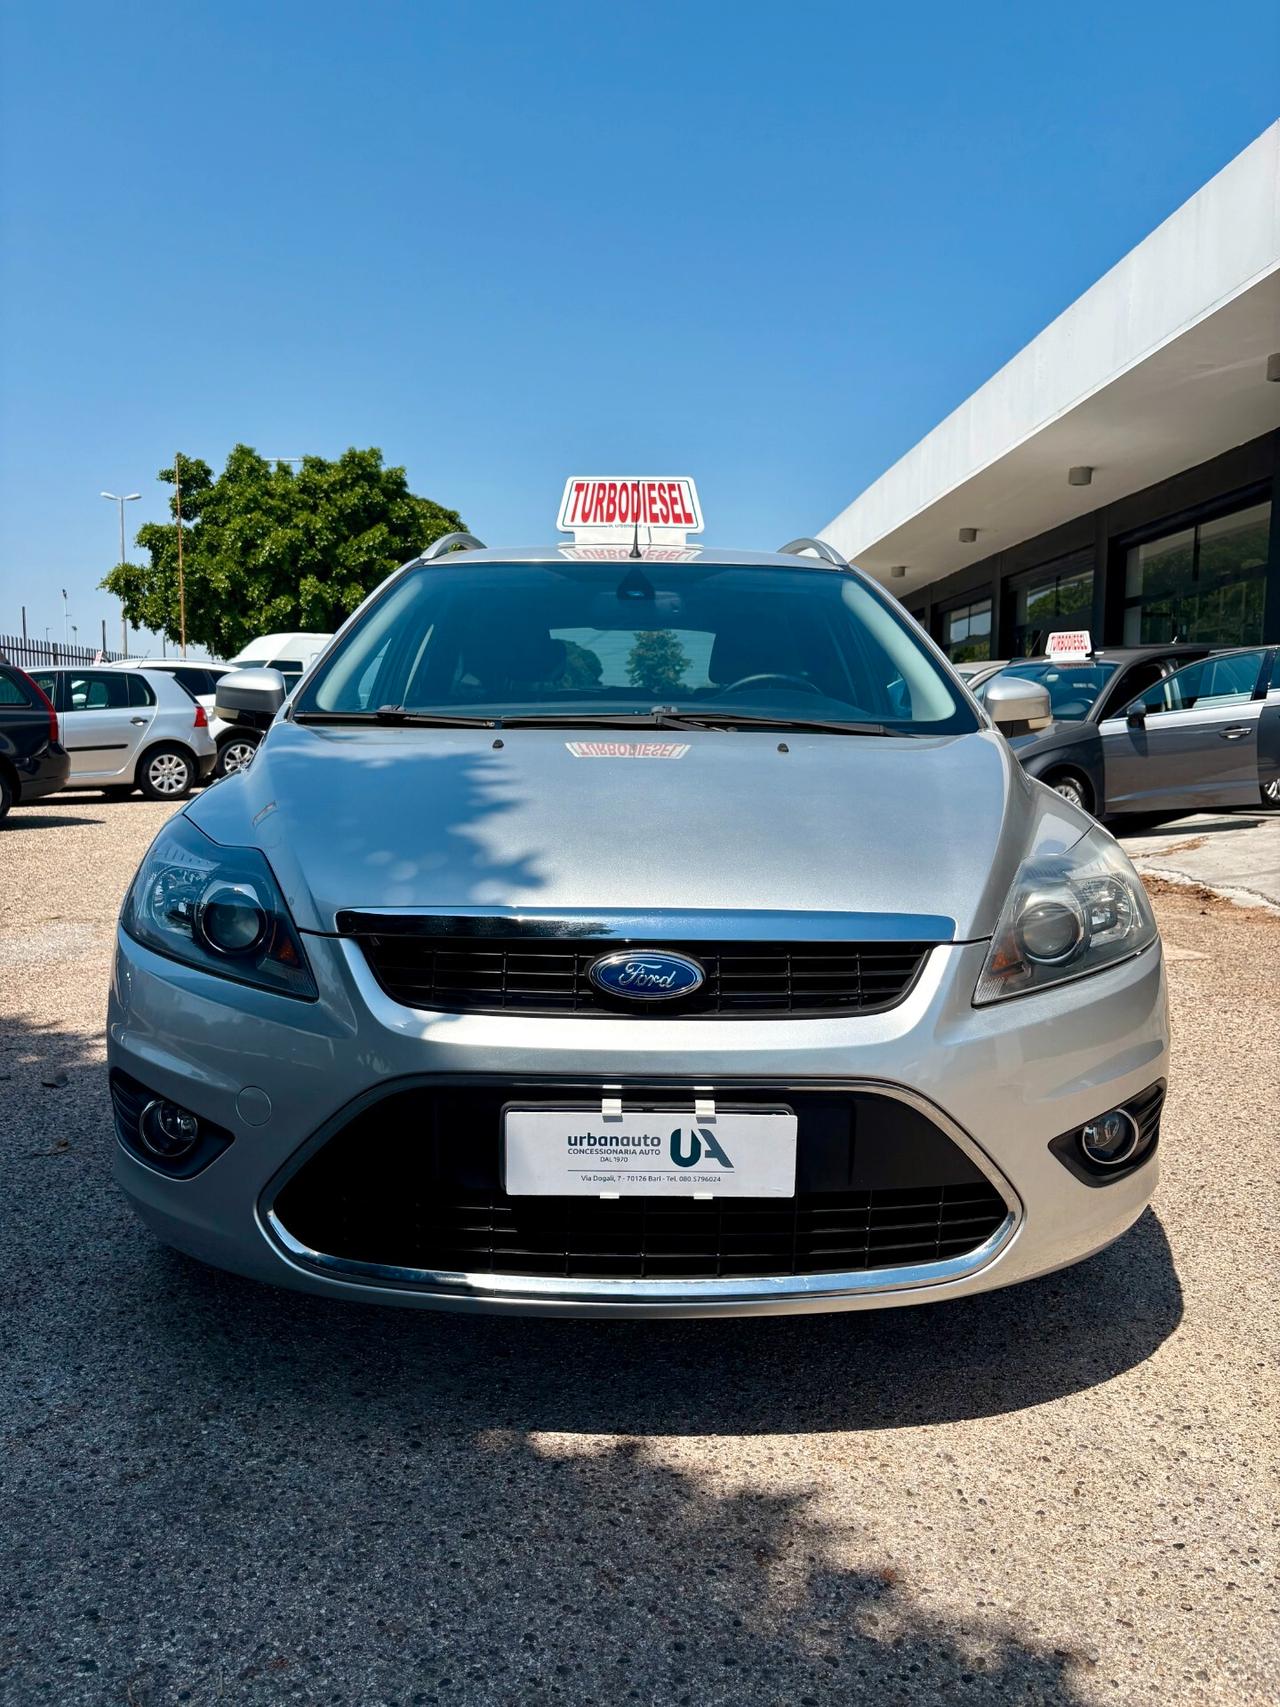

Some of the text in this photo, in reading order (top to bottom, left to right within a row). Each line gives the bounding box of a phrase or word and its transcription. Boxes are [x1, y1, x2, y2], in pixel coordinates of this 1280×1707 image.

[570, 482, 694, 524] TURBODIESEL
[618, 962, 677, 988] Ford
[567, 1132, 662, 1147] urbanauto
[638, 1148, 661, 1156] AUTO
